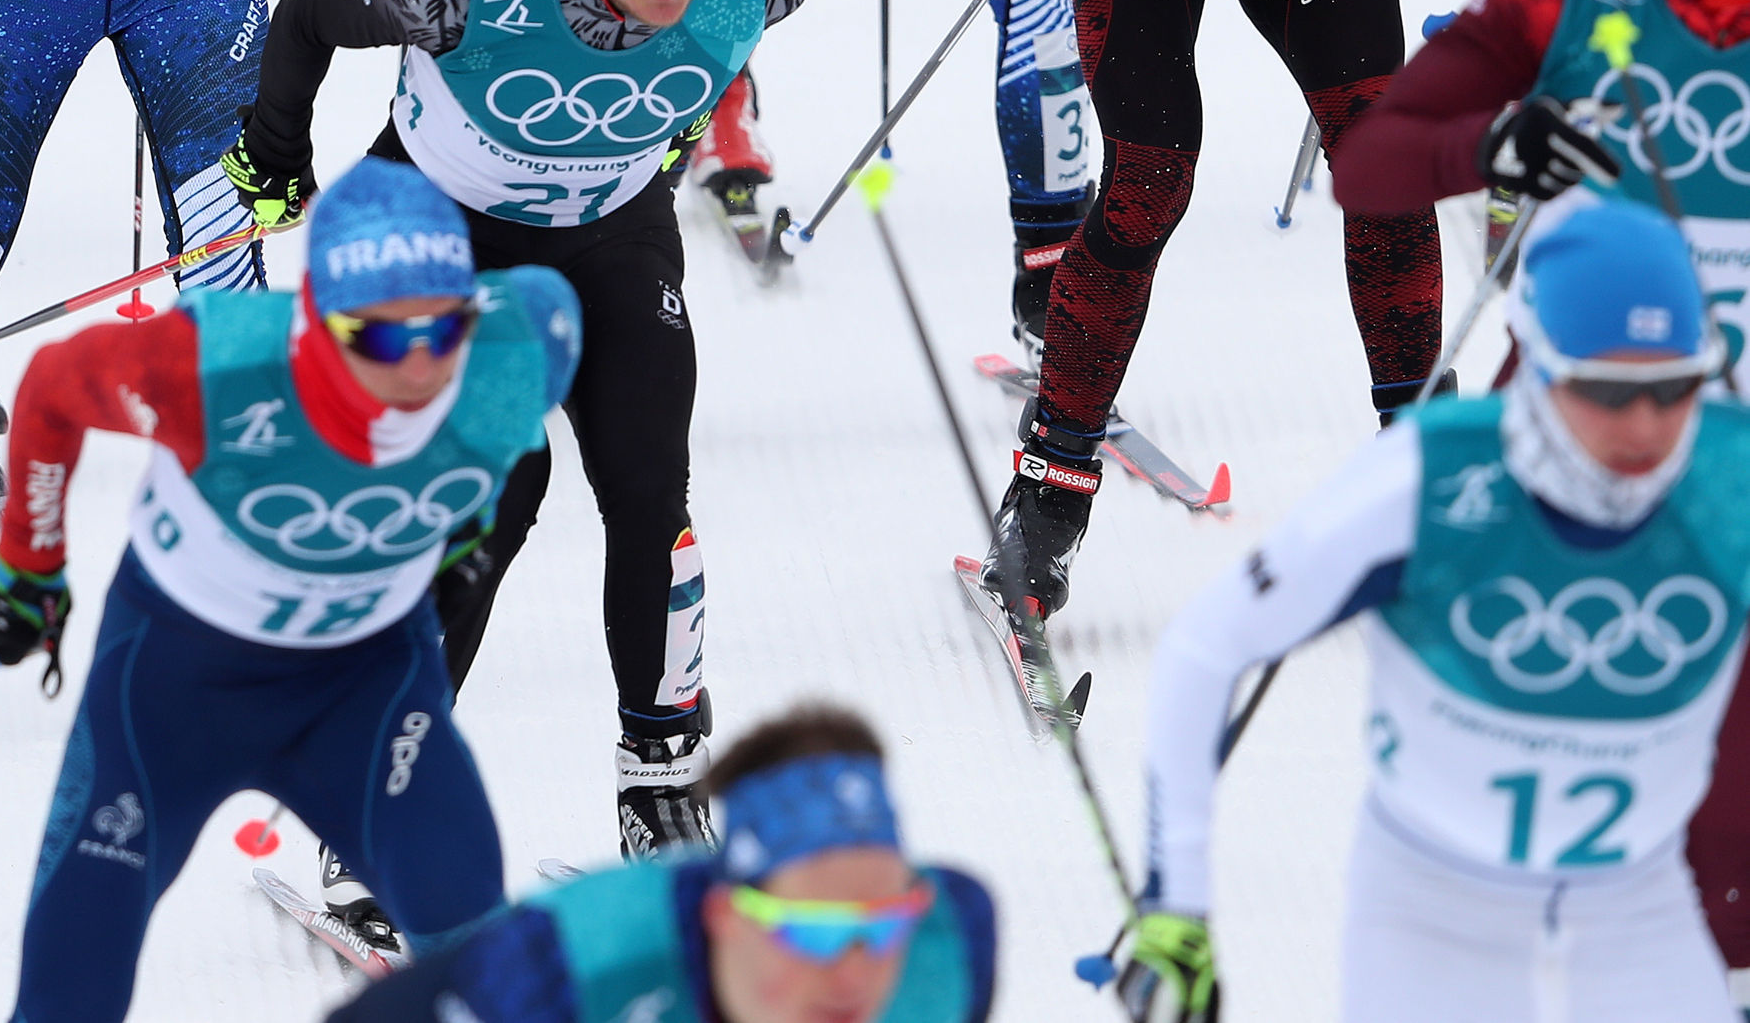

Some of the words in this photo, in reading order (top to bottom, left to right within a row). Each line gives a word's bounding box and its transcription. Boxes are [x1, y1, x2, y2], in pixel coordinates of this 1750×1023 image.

[230, 2, 263, 62] CRAFT
[1057, 99, 1088, 162] 3
[386, 711, 431, 797] odlo
[620, 767, 691, 778] MADSHUS
[1490, 771, 1639, 868] 12
[311, 911, 371, 960] MADSHUS
